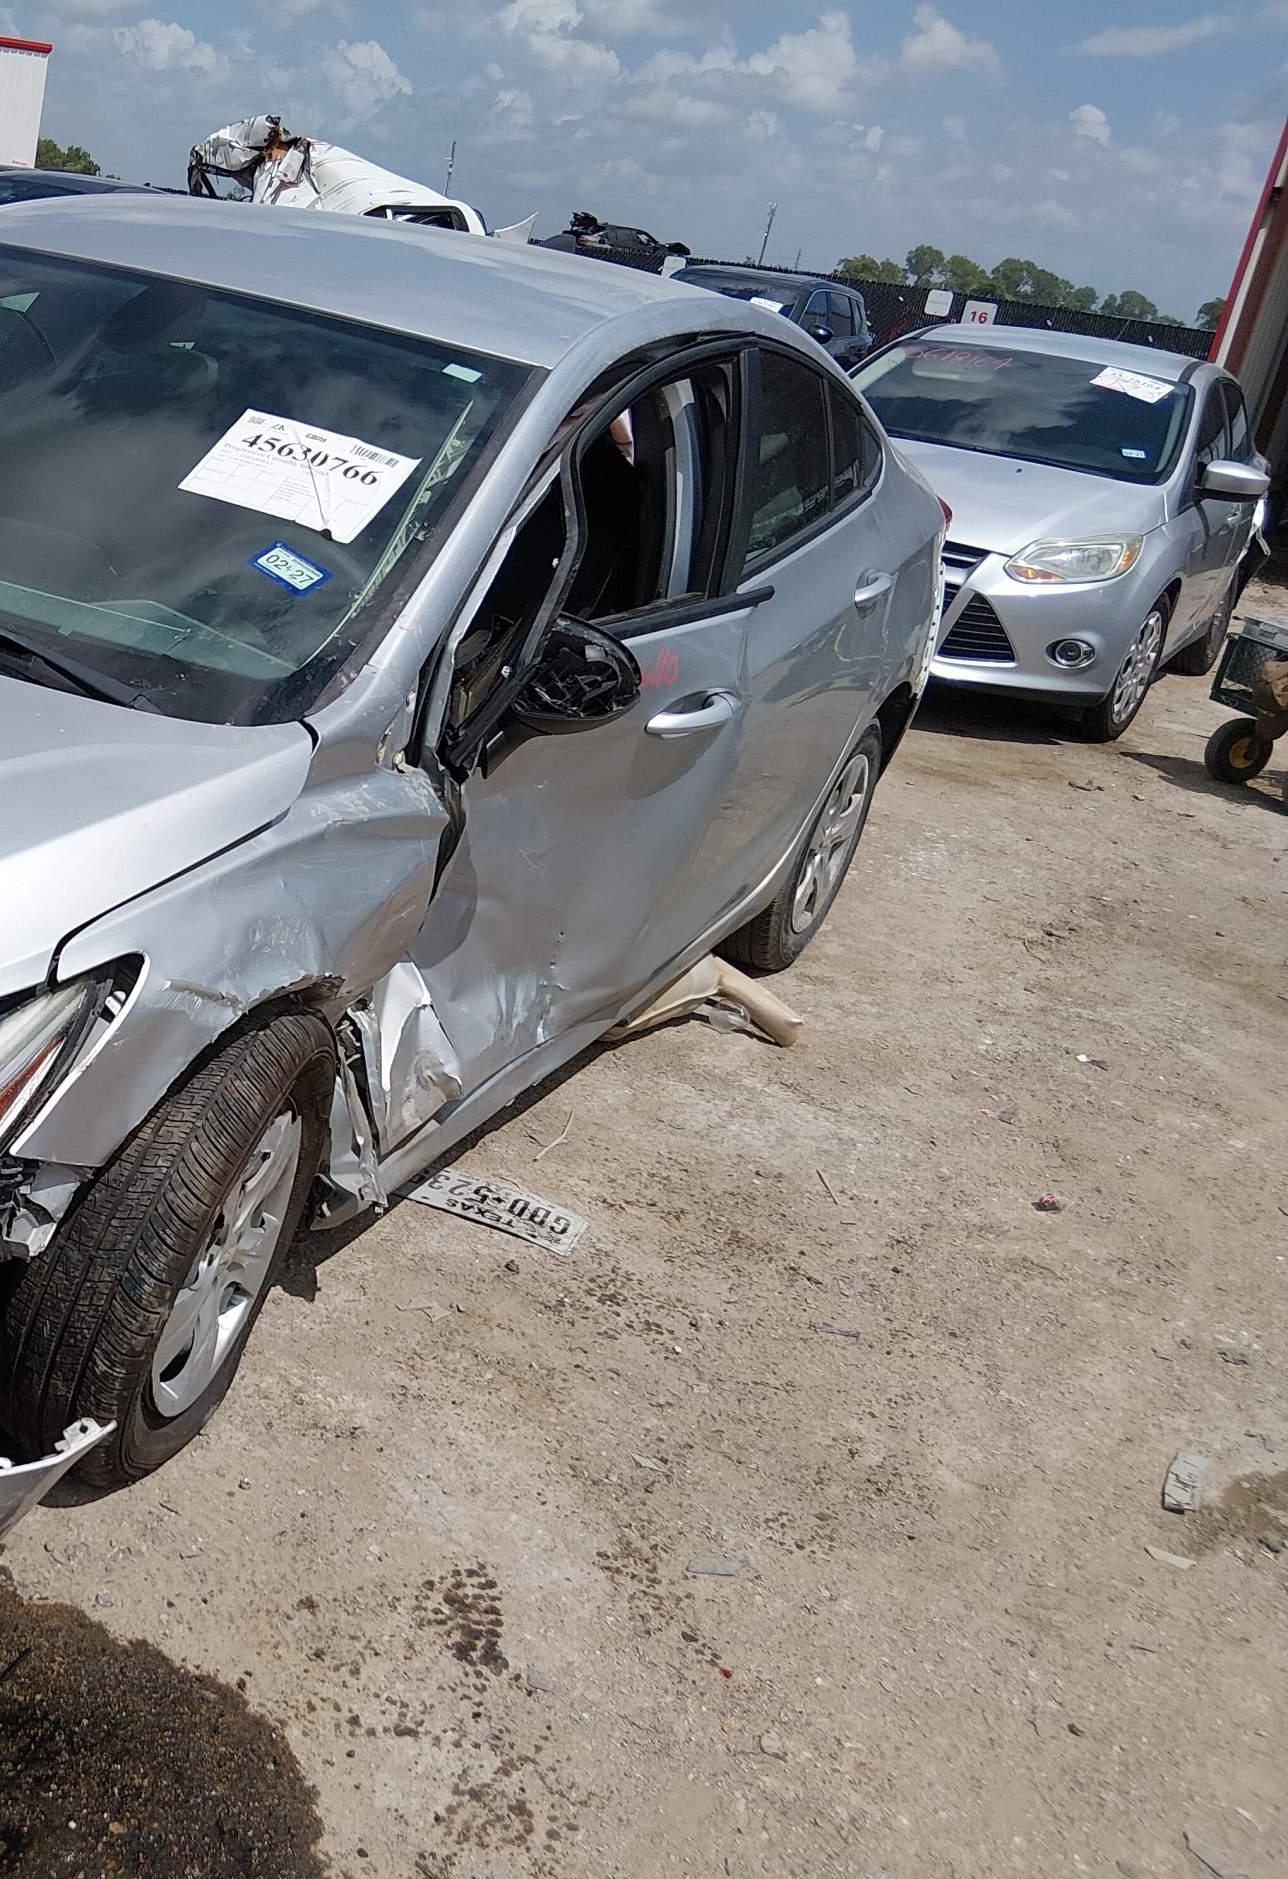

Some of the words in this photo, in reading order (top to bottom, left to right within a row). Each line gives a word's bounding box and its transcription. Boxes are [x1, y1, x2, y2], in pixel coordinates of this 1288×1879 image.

[971, 310, 989, 325] 16
[241, 433, 385, 486] 45630766
[445, 1198, 514, 1228] TEXAS
